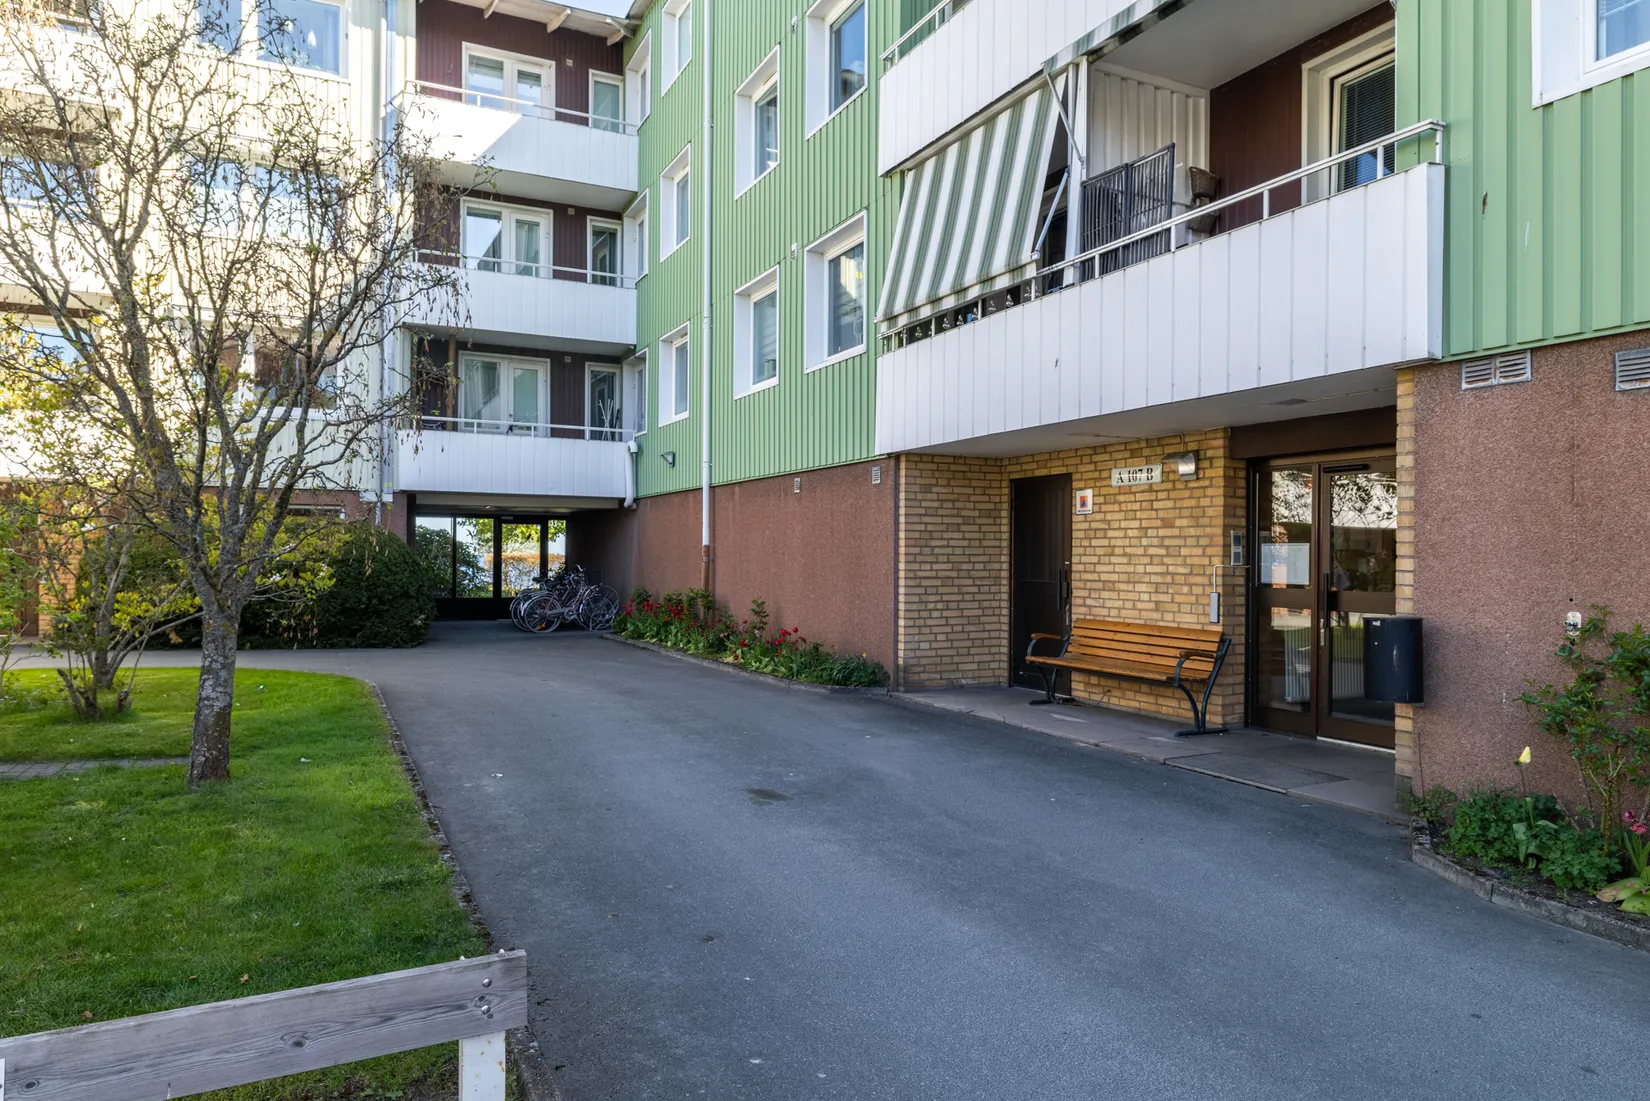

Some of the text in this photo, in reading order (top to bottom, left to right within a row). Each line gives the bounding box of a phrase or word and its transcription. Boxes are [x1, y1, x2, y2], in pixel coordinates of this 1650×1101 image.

[1116, 467, 1153, 483] A 107 B
